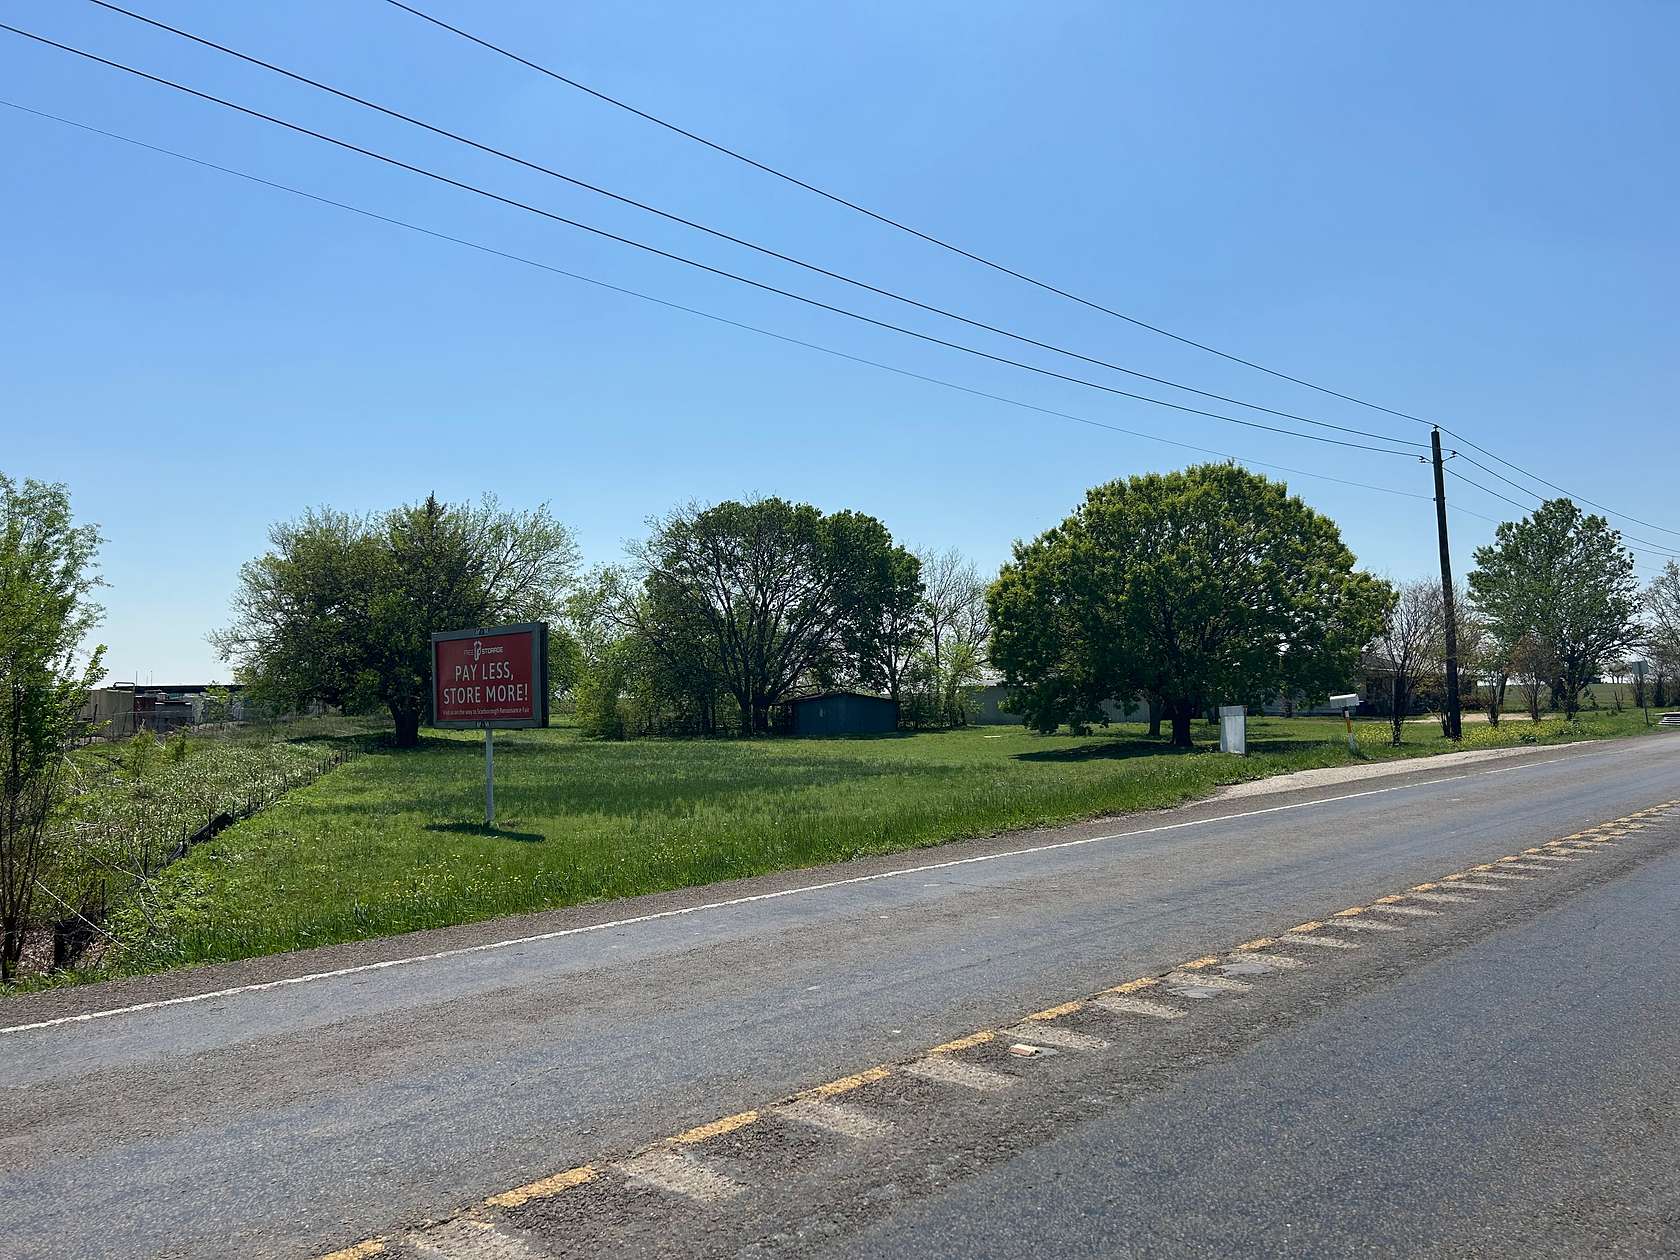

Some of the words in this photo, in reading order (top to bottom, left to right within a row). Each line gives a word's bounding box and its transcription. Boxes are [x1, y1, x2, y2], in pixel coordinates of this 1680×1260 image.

[455, 664, 478, 682] PAY
[482, 661, 514, 681] LESS,
[443, 686, 481, 705] STORE
[486, 683, 528, 703] MORE!
